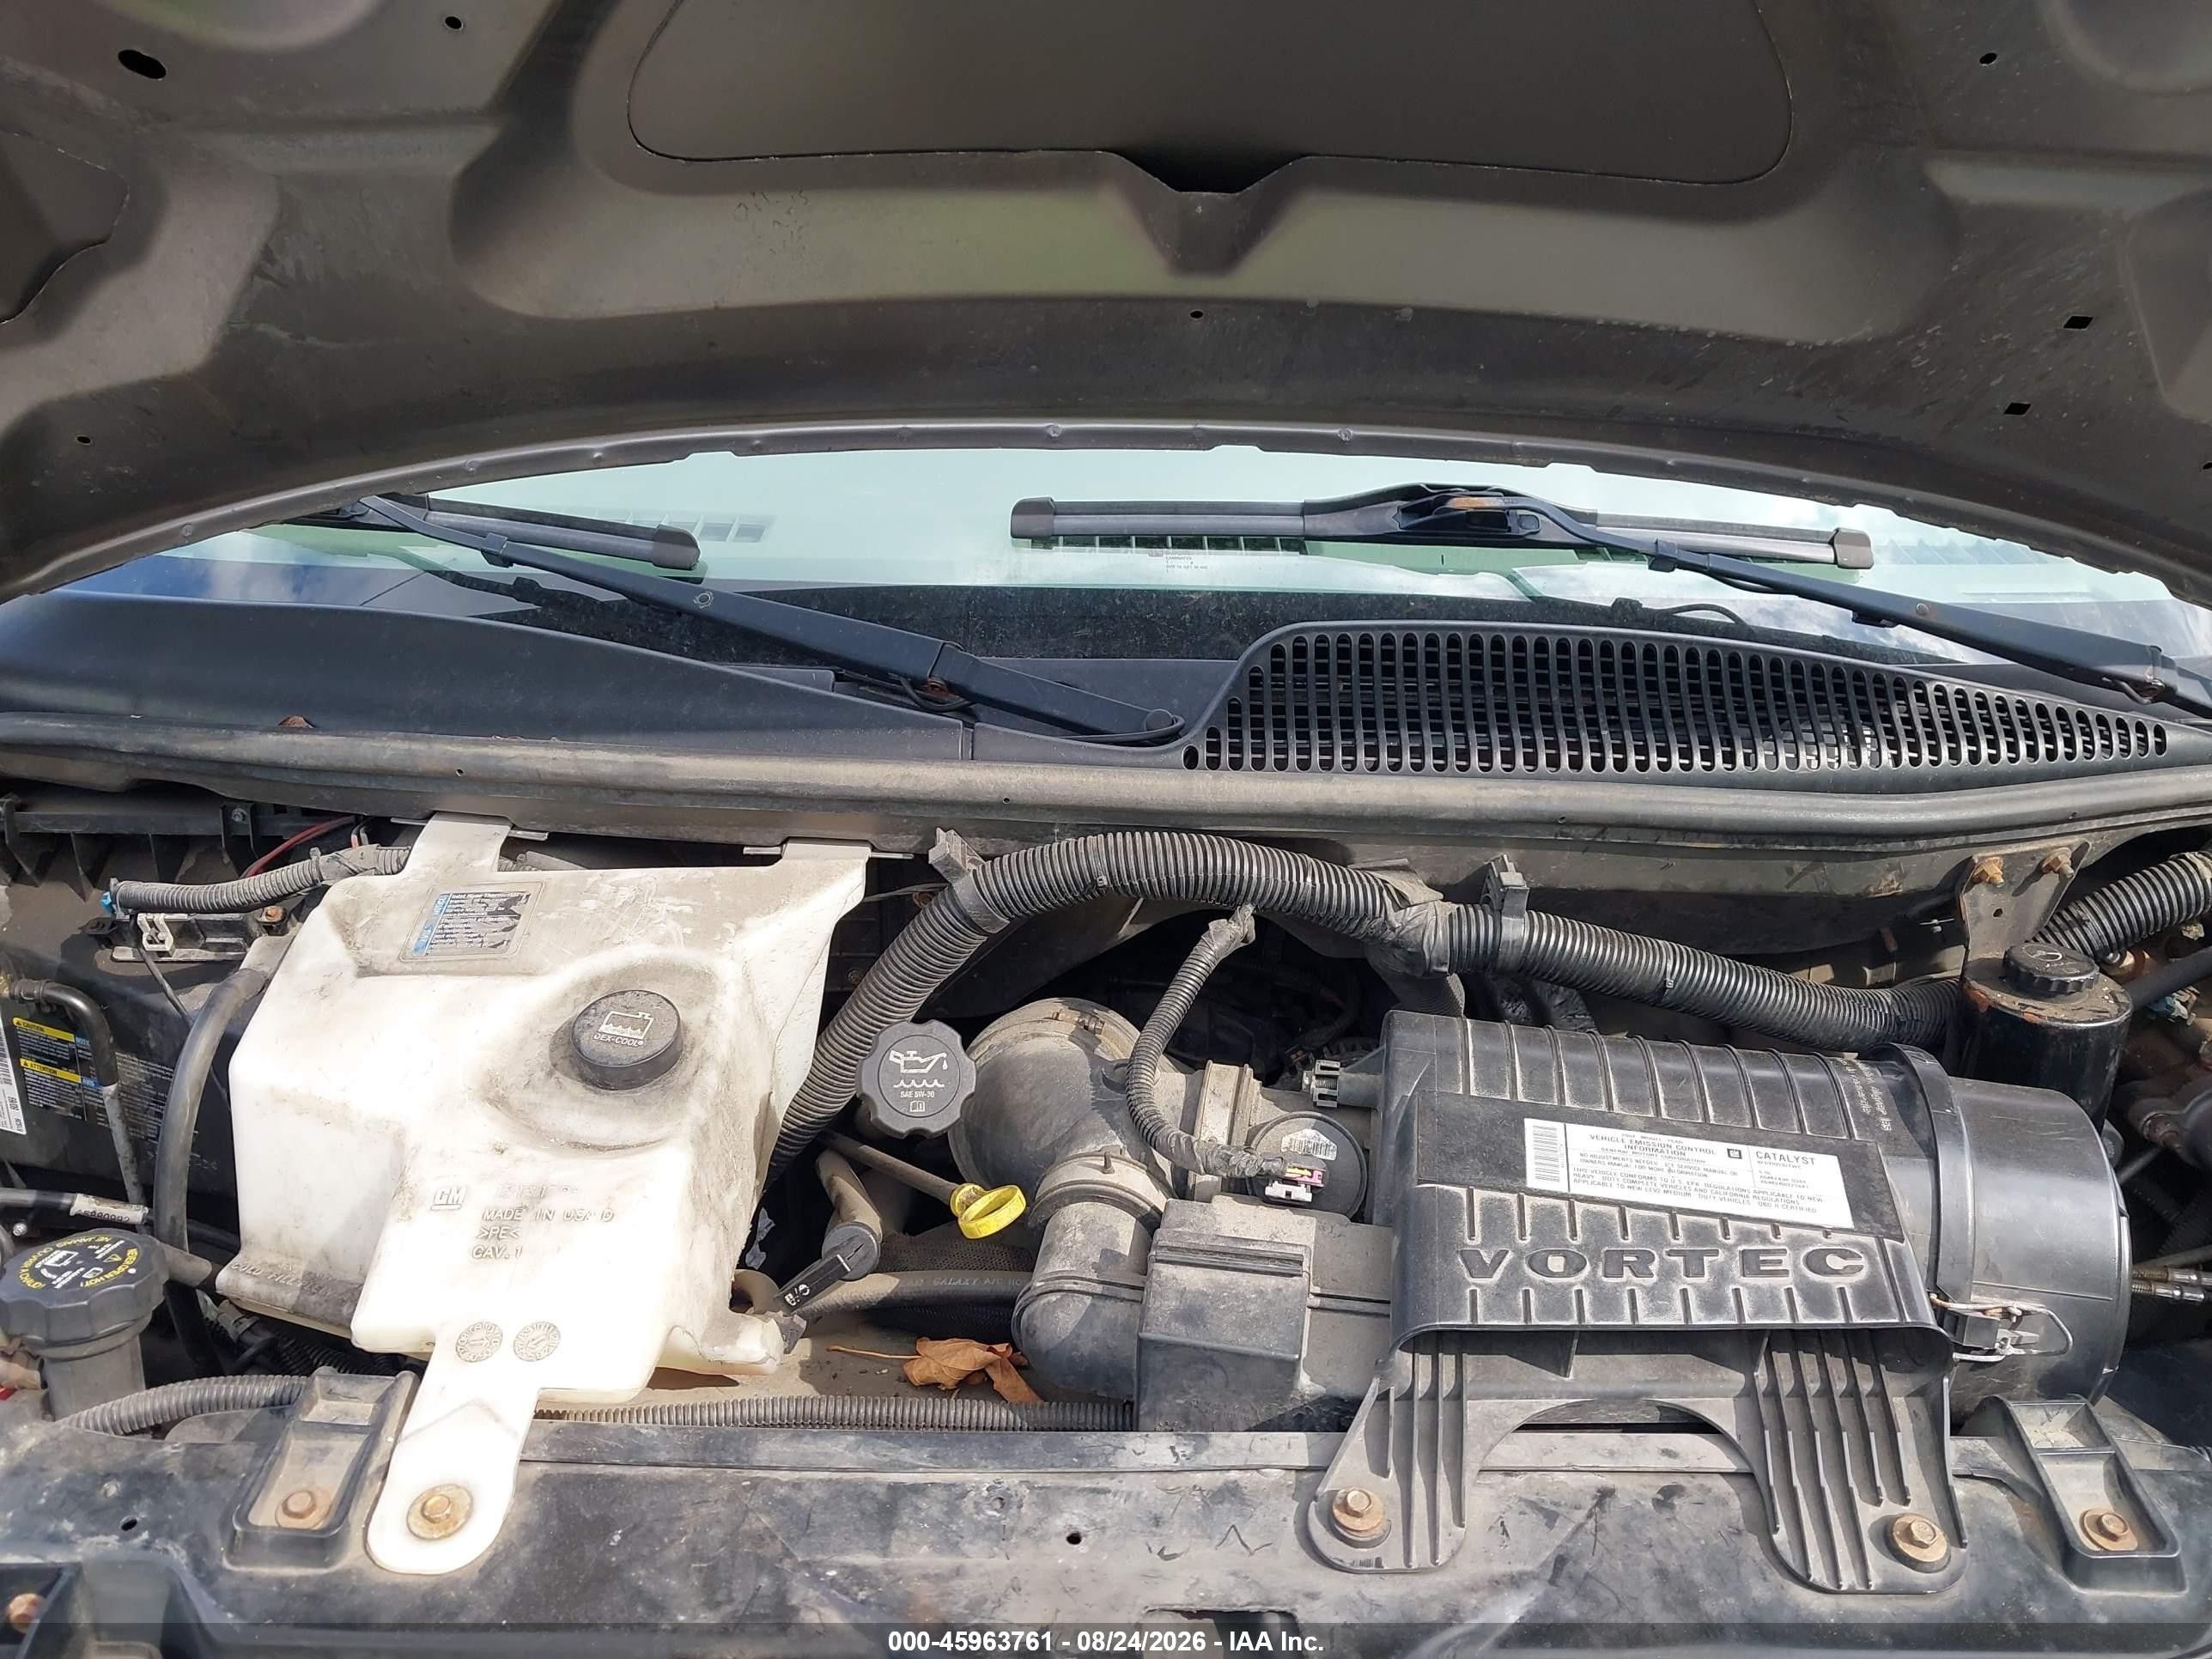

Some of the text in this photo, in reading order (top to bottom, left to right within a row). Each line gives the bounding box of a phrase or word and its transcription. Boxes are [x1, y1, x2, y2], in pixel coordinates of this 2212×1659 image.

[1589, 1133, 1716, 1154] VEHICLE EMISSION CONTROL
[1624, 1144, 1685, 1156] INFORMATION
[1755, 1150, 1814, 1165] CATALYST
[1620, 1172, 1656, 1181] CONFORMS
[1704, 1182, 1750, 1194] REGULATIONS
[1753, 1188, 1793, 1198] APPLICABLE
[1623, 1178, 1657, 1187] COMPLETE
[1660, 1182, 1692, 1191] VEHICLES
[1710, 1188, 1750, 1198] CALIFORNIA
[1753, 1194, 1800, 1205] REGULATIONS
[433, 1187, 466, 1211] GM
[1573, 1177, 1613, 1187] APPLICABLE
[1663, 1188, 1691, 1197] MEDIUM
[1718, 1195, 1750, 1205] VEHICLES
[1781, 1203, 1817, 1212] CERTIFIED
[482, 1208, 523, 1221] MADE
[535, 1208, 555, 1221] IN
[477, 1226, 520, 1239] >PE<
[472, 1245, 523, 1260] CAV. 1
[230, 1262, 262, 1276] COLD
[1459, 1247, 1865, 1279] VORTEC
[84, 1276, 106, 1287] HOT
[983, 1277, 1004, 1285] A/C
